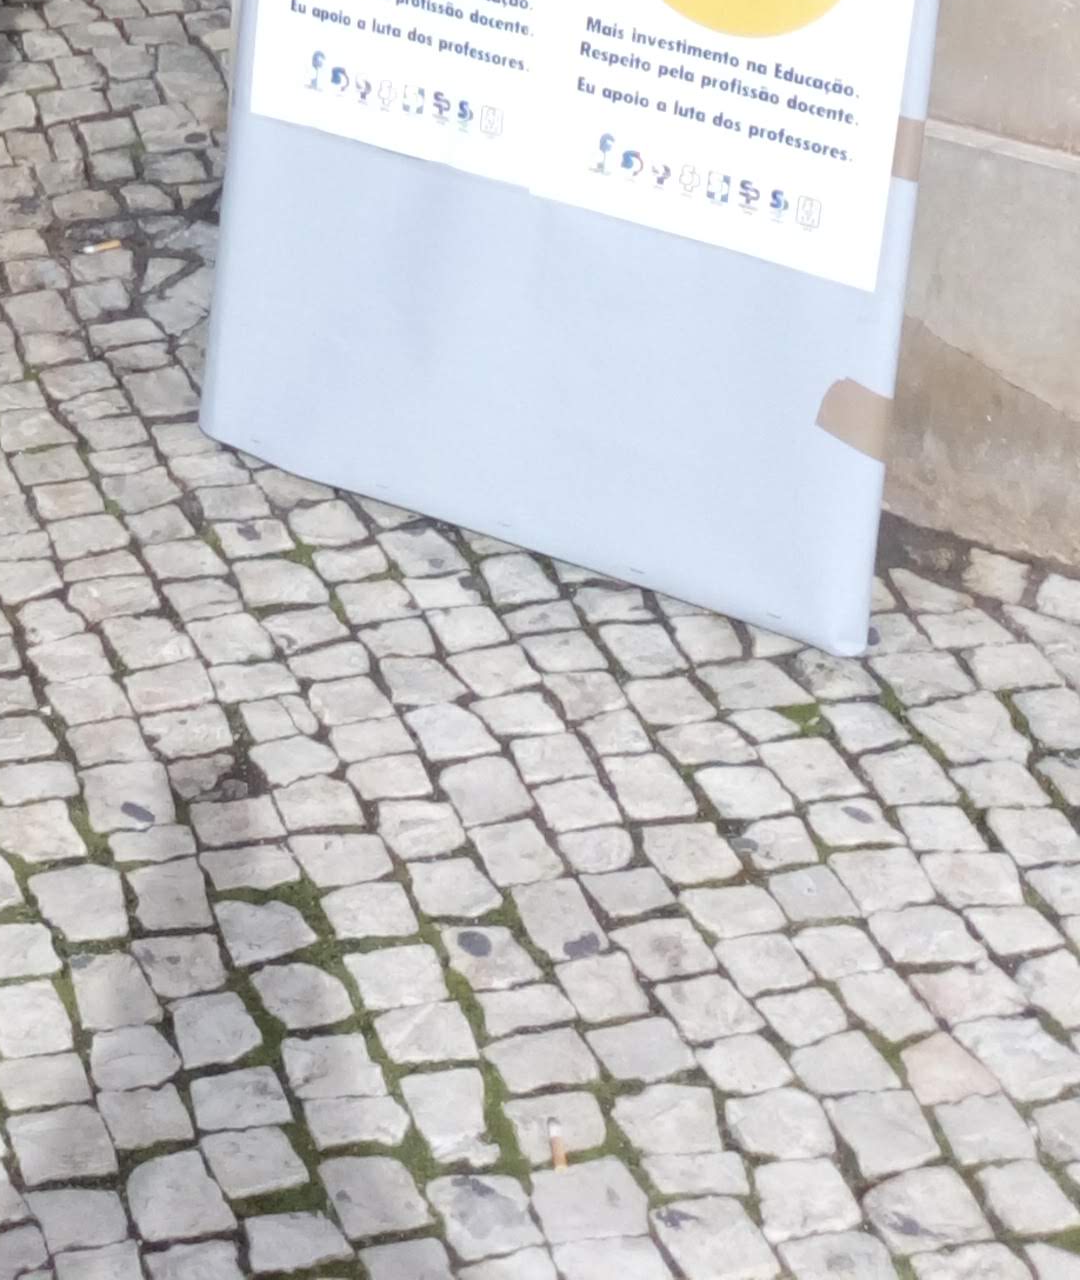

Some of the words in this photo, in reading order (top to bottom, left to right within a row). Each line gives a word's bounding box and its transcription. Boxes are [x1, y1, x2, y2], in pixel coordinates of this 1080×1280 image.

[312, 7, 350, 25] apoio
[357, 19, 365, 29] a
[372, 18, 400, 37] luta
[407, 27, 432, 46] dos
[438, 39, 529, 72] professores.
[469, 9, 533, 37] docente.
[586, 16, 623, 39] Mais
[632, 27, 739, 67] investimento
[746, 60, 766, 75] na
[774, 63, 858, 97] Educação.
[577, 76, 595, 94] Eu
[602, 87, 648, 107] apoio
[656, 101, 666, 112] a
[674, 100, 705, 122] luta
[712, 112, 740, 131] dos
[748, 125, 853, 160] professores.
[580, 41, 650, 71] Respeito
[658, 65, 694, 82] pela
[700, 75, 779, 104] profissão
[786, 94, 859, 125] docente.
